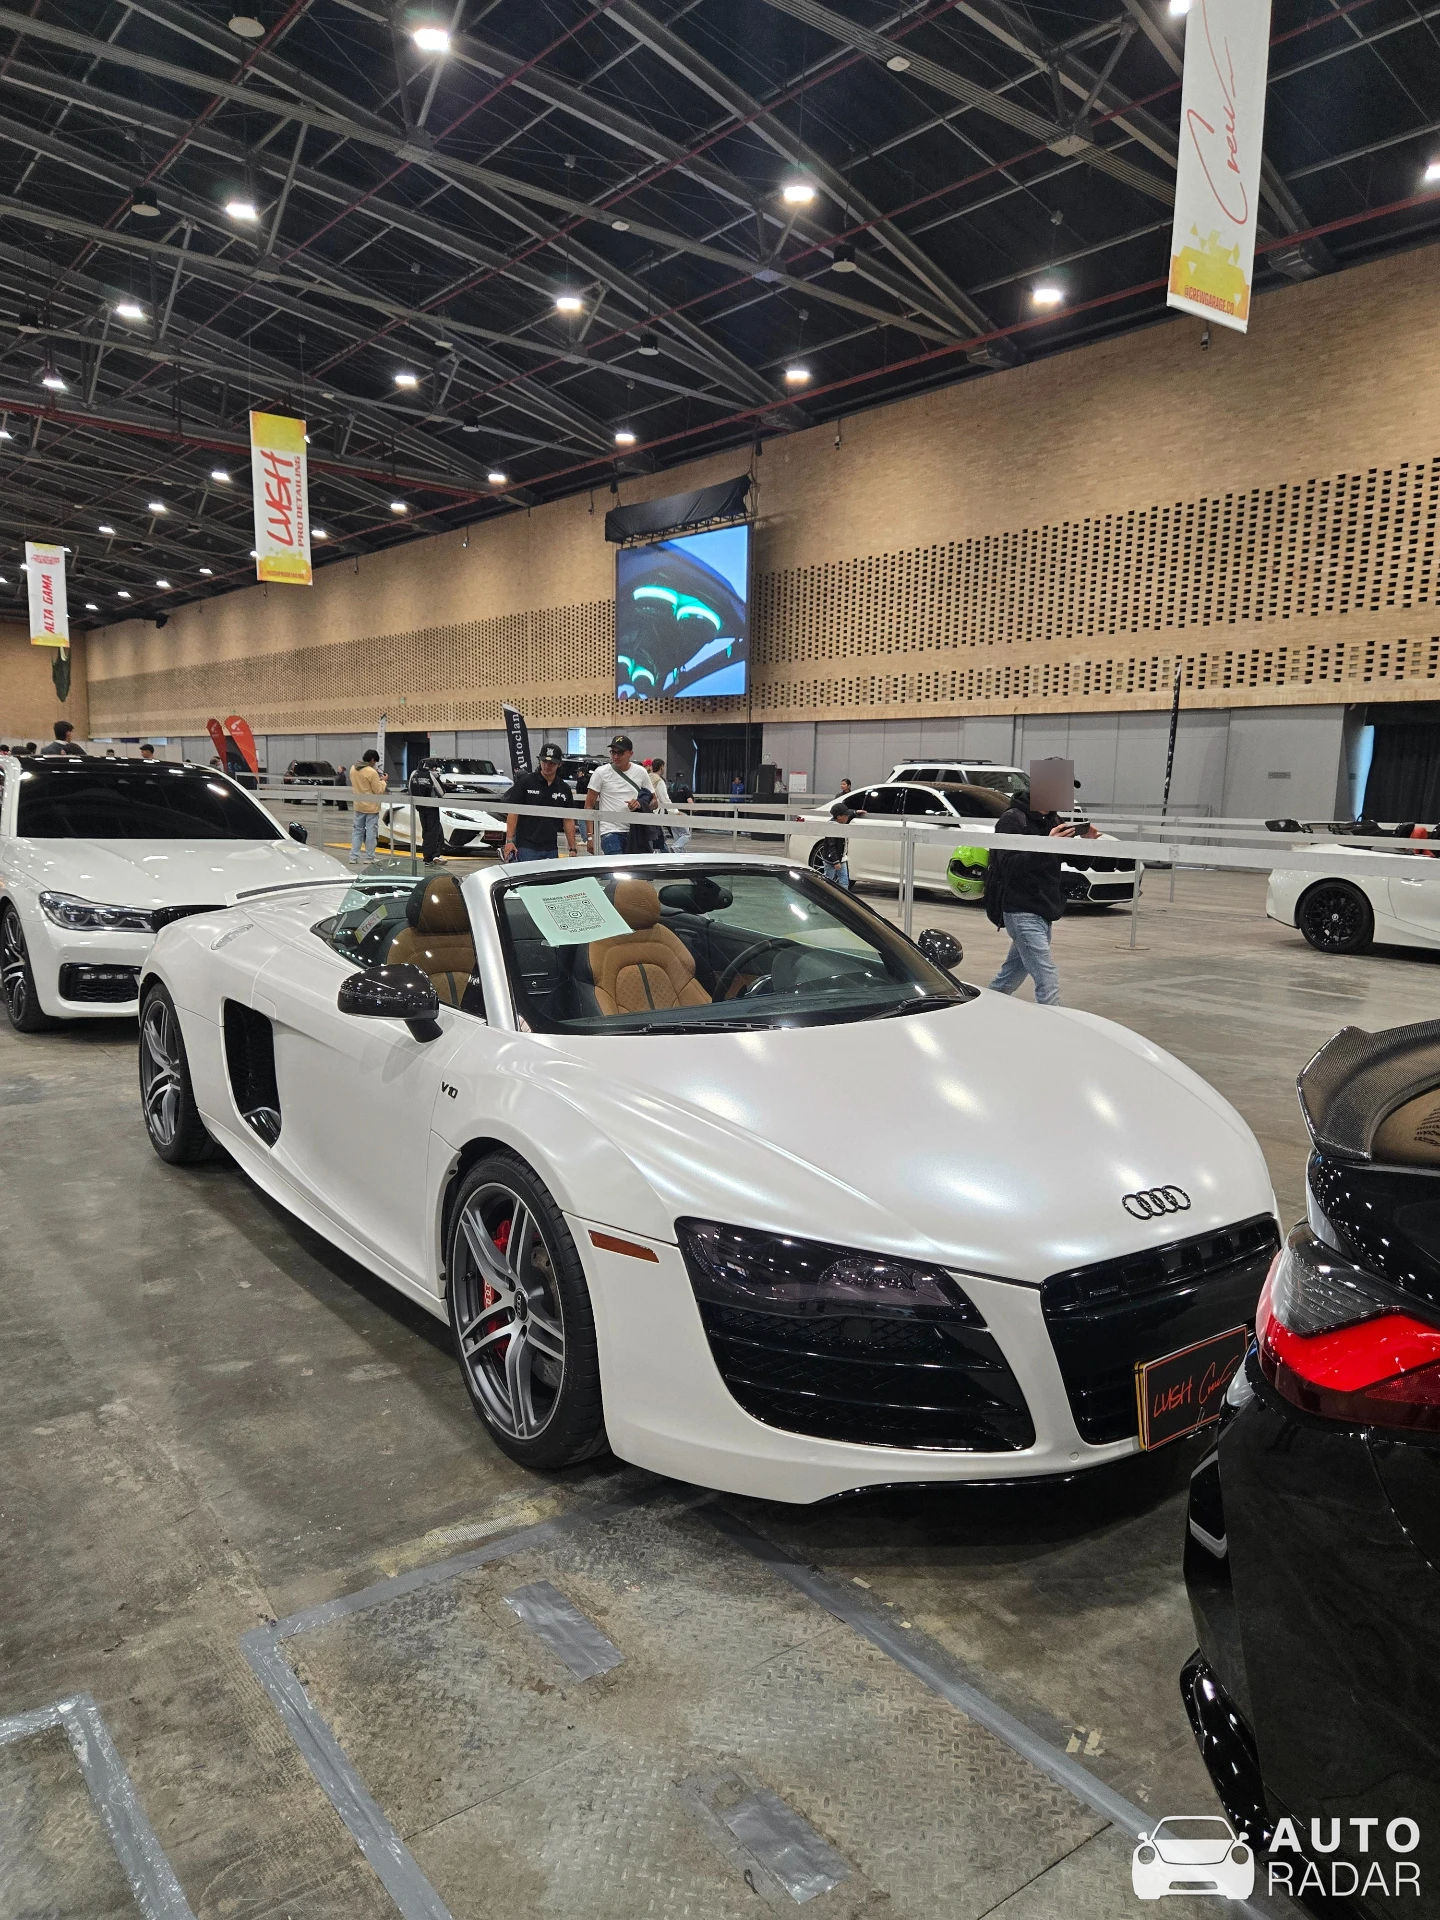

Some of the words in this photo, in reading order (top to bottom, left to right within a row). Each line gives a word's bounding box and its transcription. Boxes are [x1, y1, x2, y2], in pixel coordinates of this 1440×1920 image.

[260, 449, 294, 547] LUSH
[294, 456, 303, 519] DETAILING
[296, 522, 304, 547] PRO
[41, 573, 53, 606] GAMA
[43, 608, 55, 634] ALTA
[441, 1081, 459, 1099] V10
[1153, 1375, 1193, 1418] LUSH
